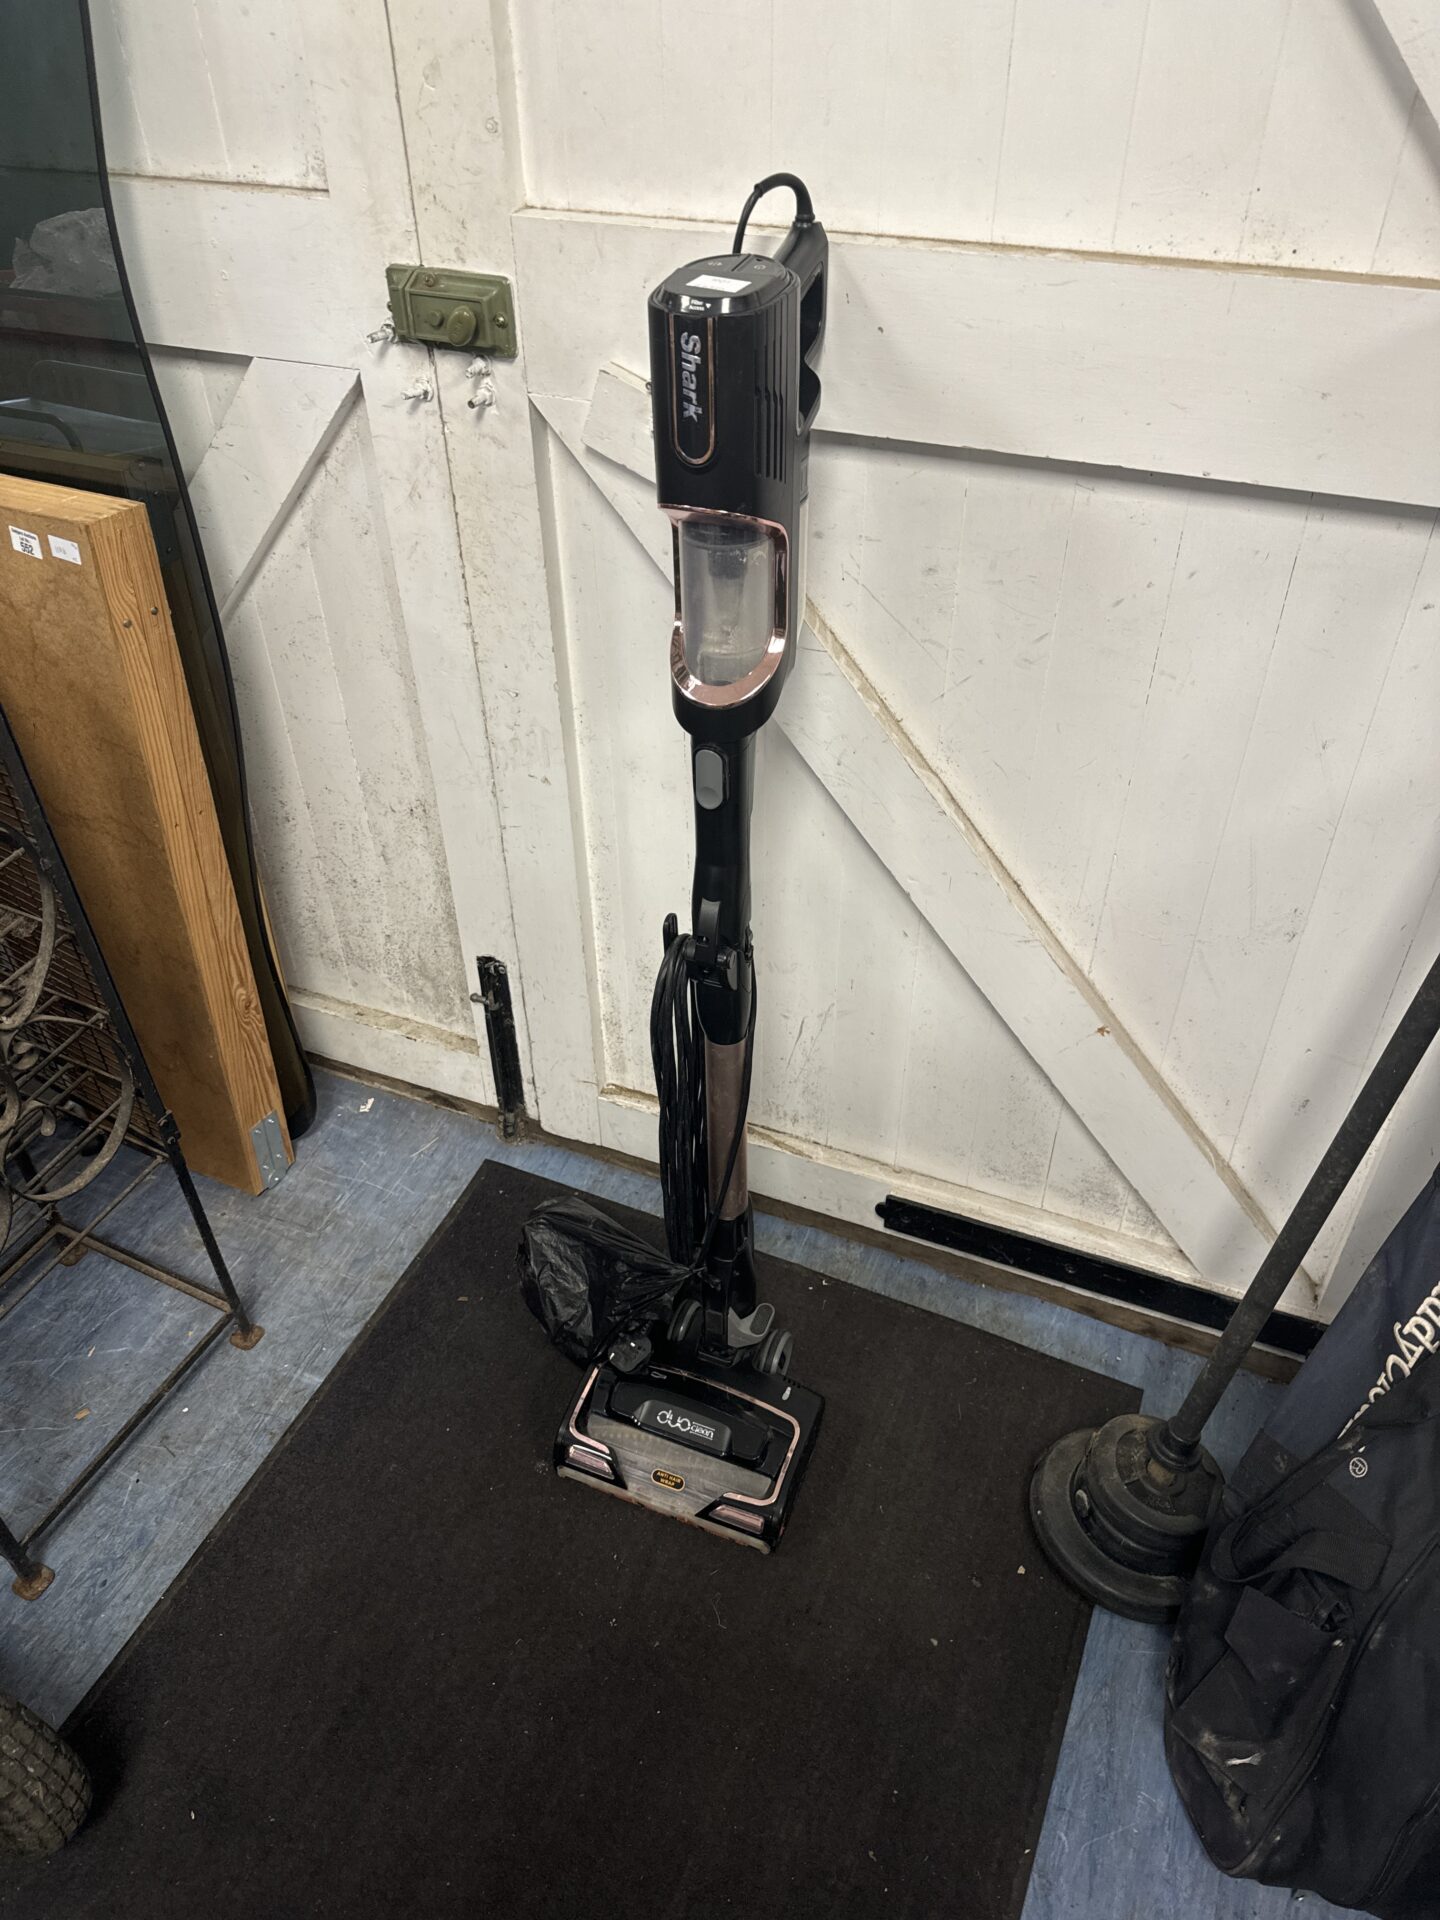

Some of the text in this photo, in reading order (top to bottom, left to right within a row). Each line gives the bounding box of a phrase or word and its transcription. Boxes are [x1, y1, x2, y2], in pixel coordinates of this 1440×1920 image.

[680, 331, 703, 423] Shark
[20, 541, 35, 556] 552
[656, 1471, 682, 1484] ANTI HAIR
